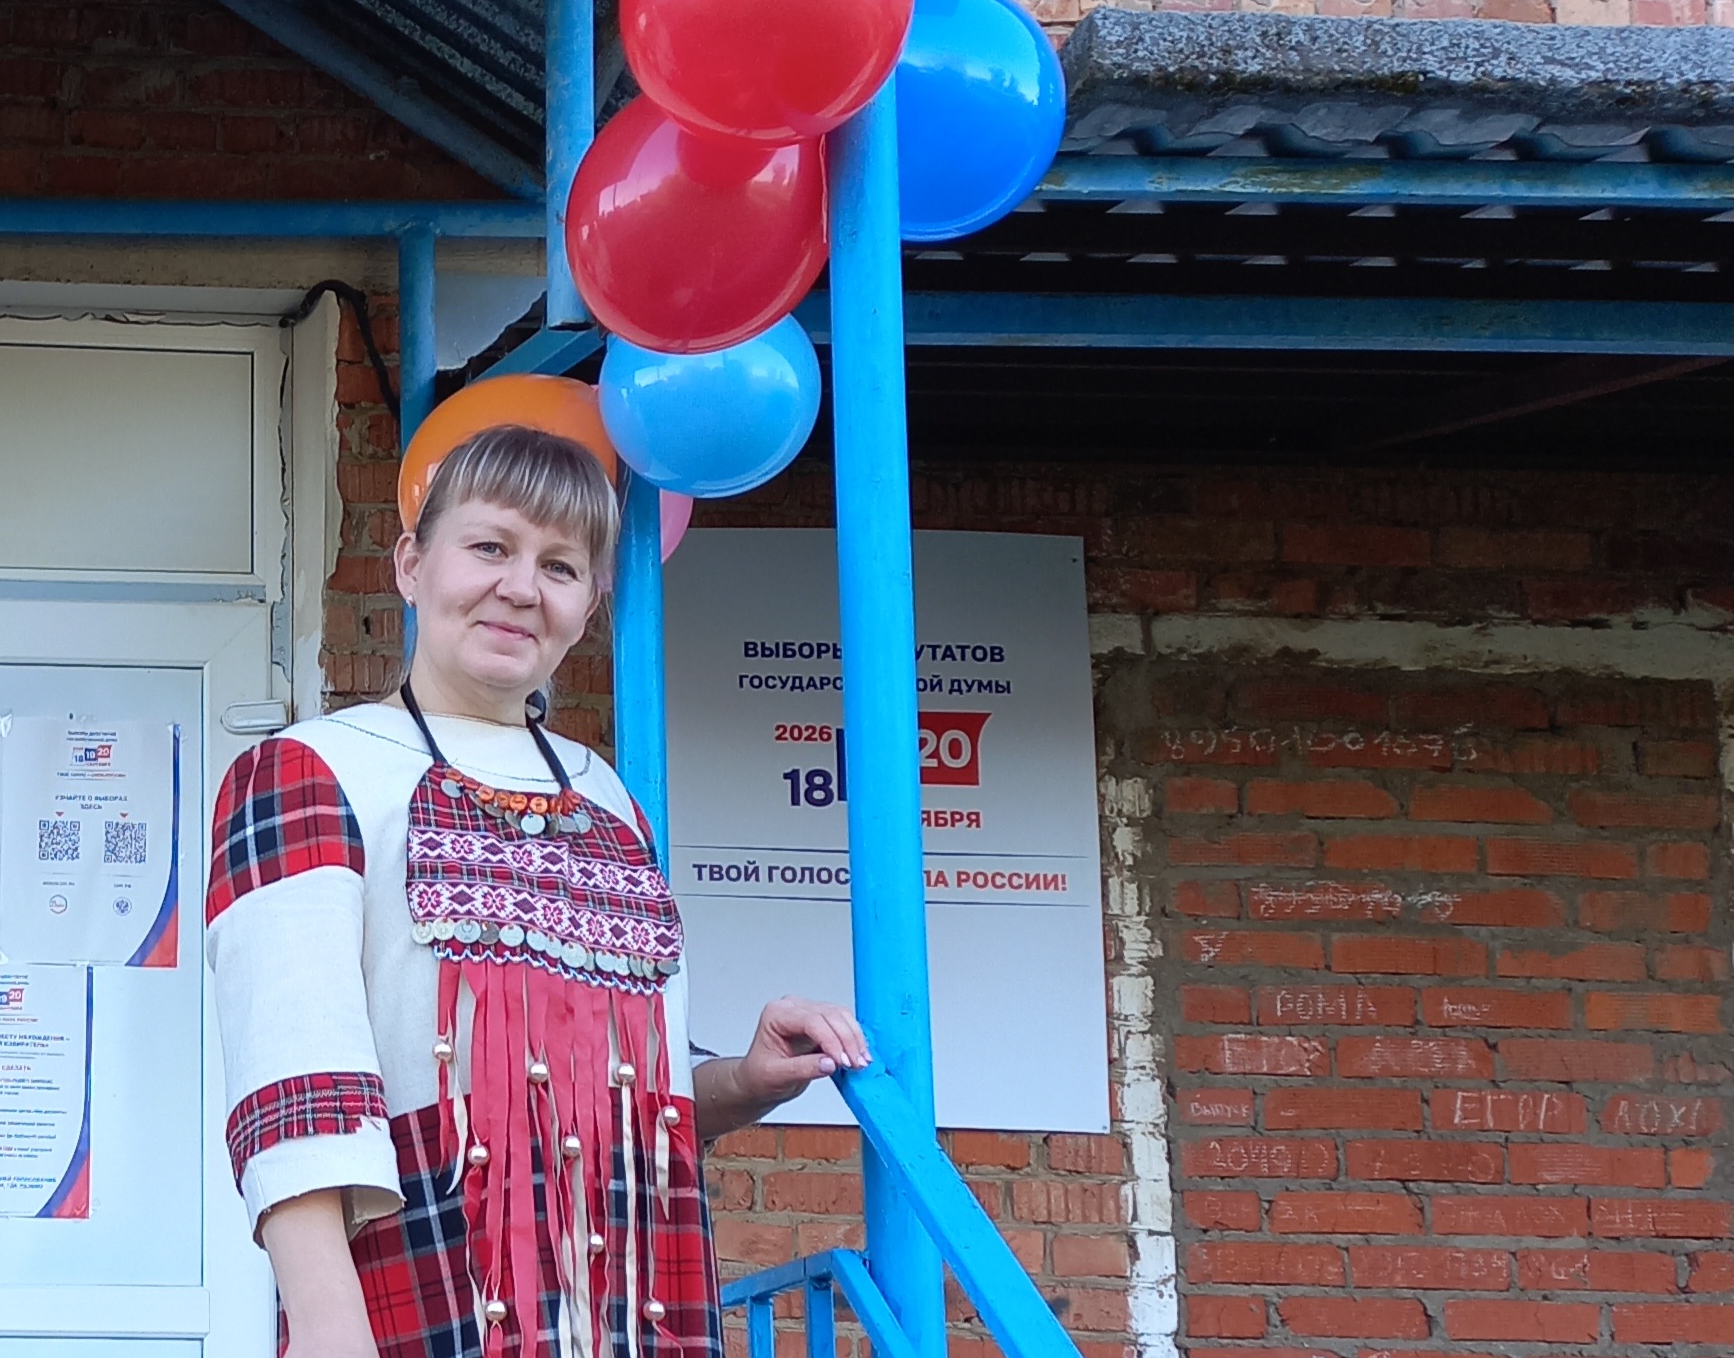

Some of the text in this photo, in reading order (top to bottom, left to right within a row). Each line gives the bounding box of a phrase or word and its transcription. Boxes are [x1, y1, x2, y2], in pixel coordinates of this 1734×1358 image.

[948, 679, 1011, 694] ДУМЫ
[774, 724, 832, 742] 2026
[782, 768, 835, 807] 18
[692, 862, 760, 883] ТВОЙ
[956, 870, 1067, 891] РОССИИ!
